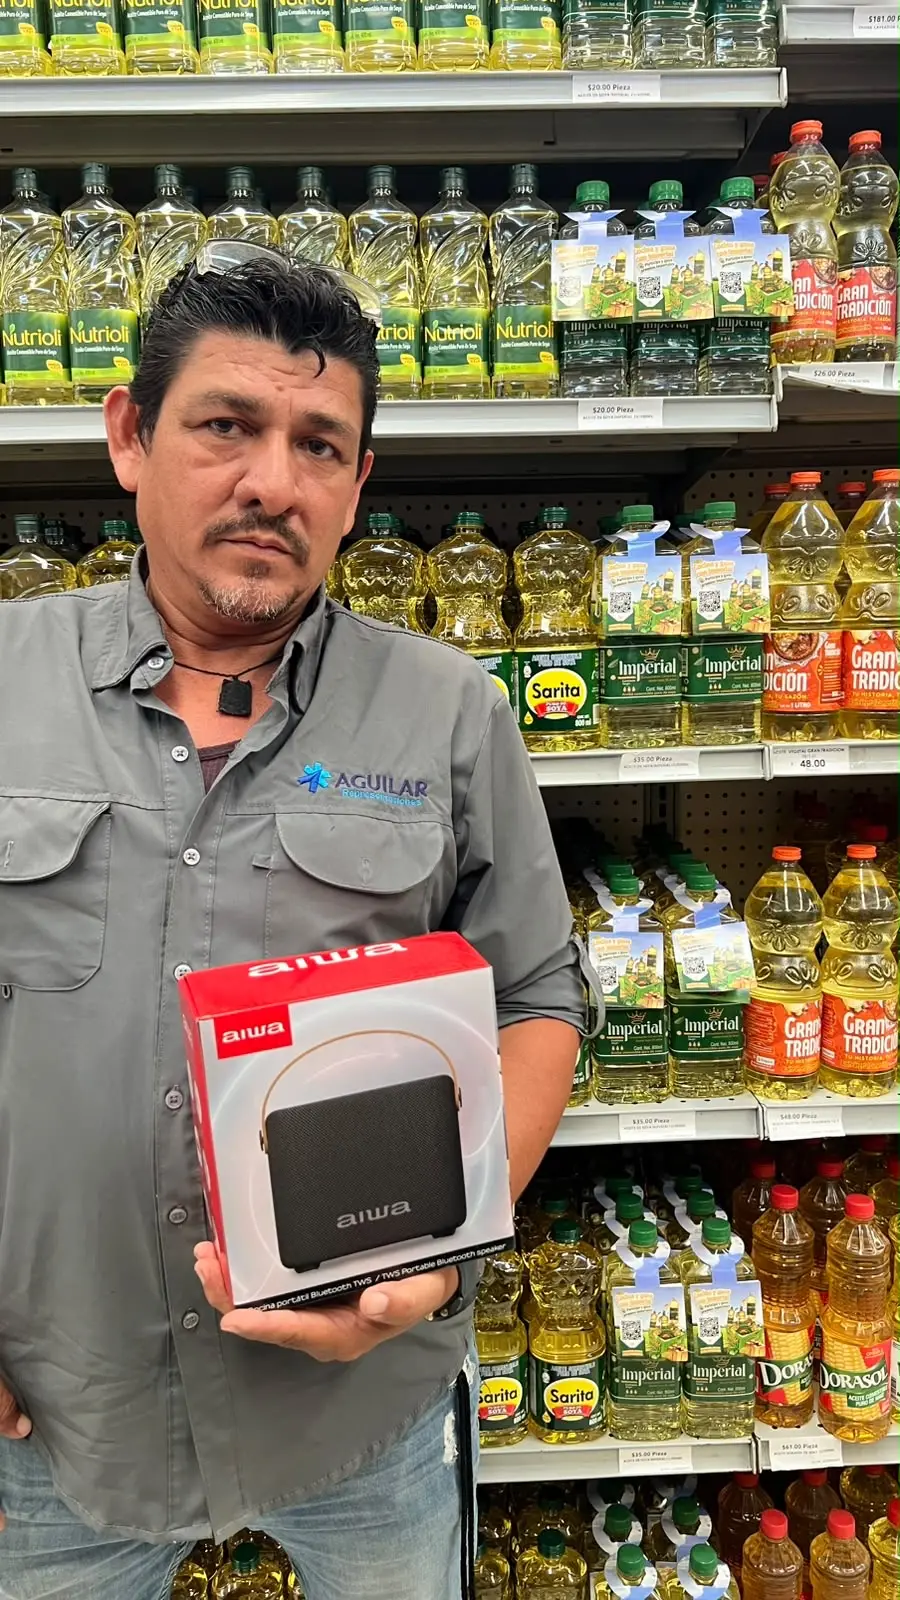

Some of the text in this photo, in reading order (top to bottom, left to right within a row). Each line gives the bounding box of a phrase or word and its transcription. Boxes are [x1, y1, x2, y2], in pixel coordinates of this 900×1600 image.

[2, 328, 62, 346] Nutrioli
[70, 326, 130, 344] Nutrioli
[424, 323, 482, 343] Nutrioli
[496, 320, 554, 339] Nutrioli
[593, 406, 614, 414] $20.00
[706, 655, 761, 679] Imperial
[852, 645, 895, 669] GRAN
[619, 657, 676, 682] Imperial
[532, 682, 580, 699] Sarita
[800, 759, 825, 768] 48.00
[335, 772, 428, 797] AGUILAR
[248, 942, 408, 979] aiwa
[221, 1020, 286, 1044] aiwa
[608, 1020, 662, 1042] Imperial
[685, 1016, 739, 1038] Imperial
[843, 1012, 885, 1035] GRAN
[336, 1200, 412, 1229] aiwa
[310, 1282, 352, 1298] Bluetooth
[353, 1276, 373, 1288] TWS
[382, 1270, 400, 1280] TWS
[401, 1261, 436, 1274] Portable
[436, 1250, 476, 1266] Bluetooth
[476, 1242, 506, 1259] speaker
[622, 1367, 675, 1386] Imperial
[693, 1364, 746, 1383] Imperial
[550, 1389, 594, 1403] Sarita
